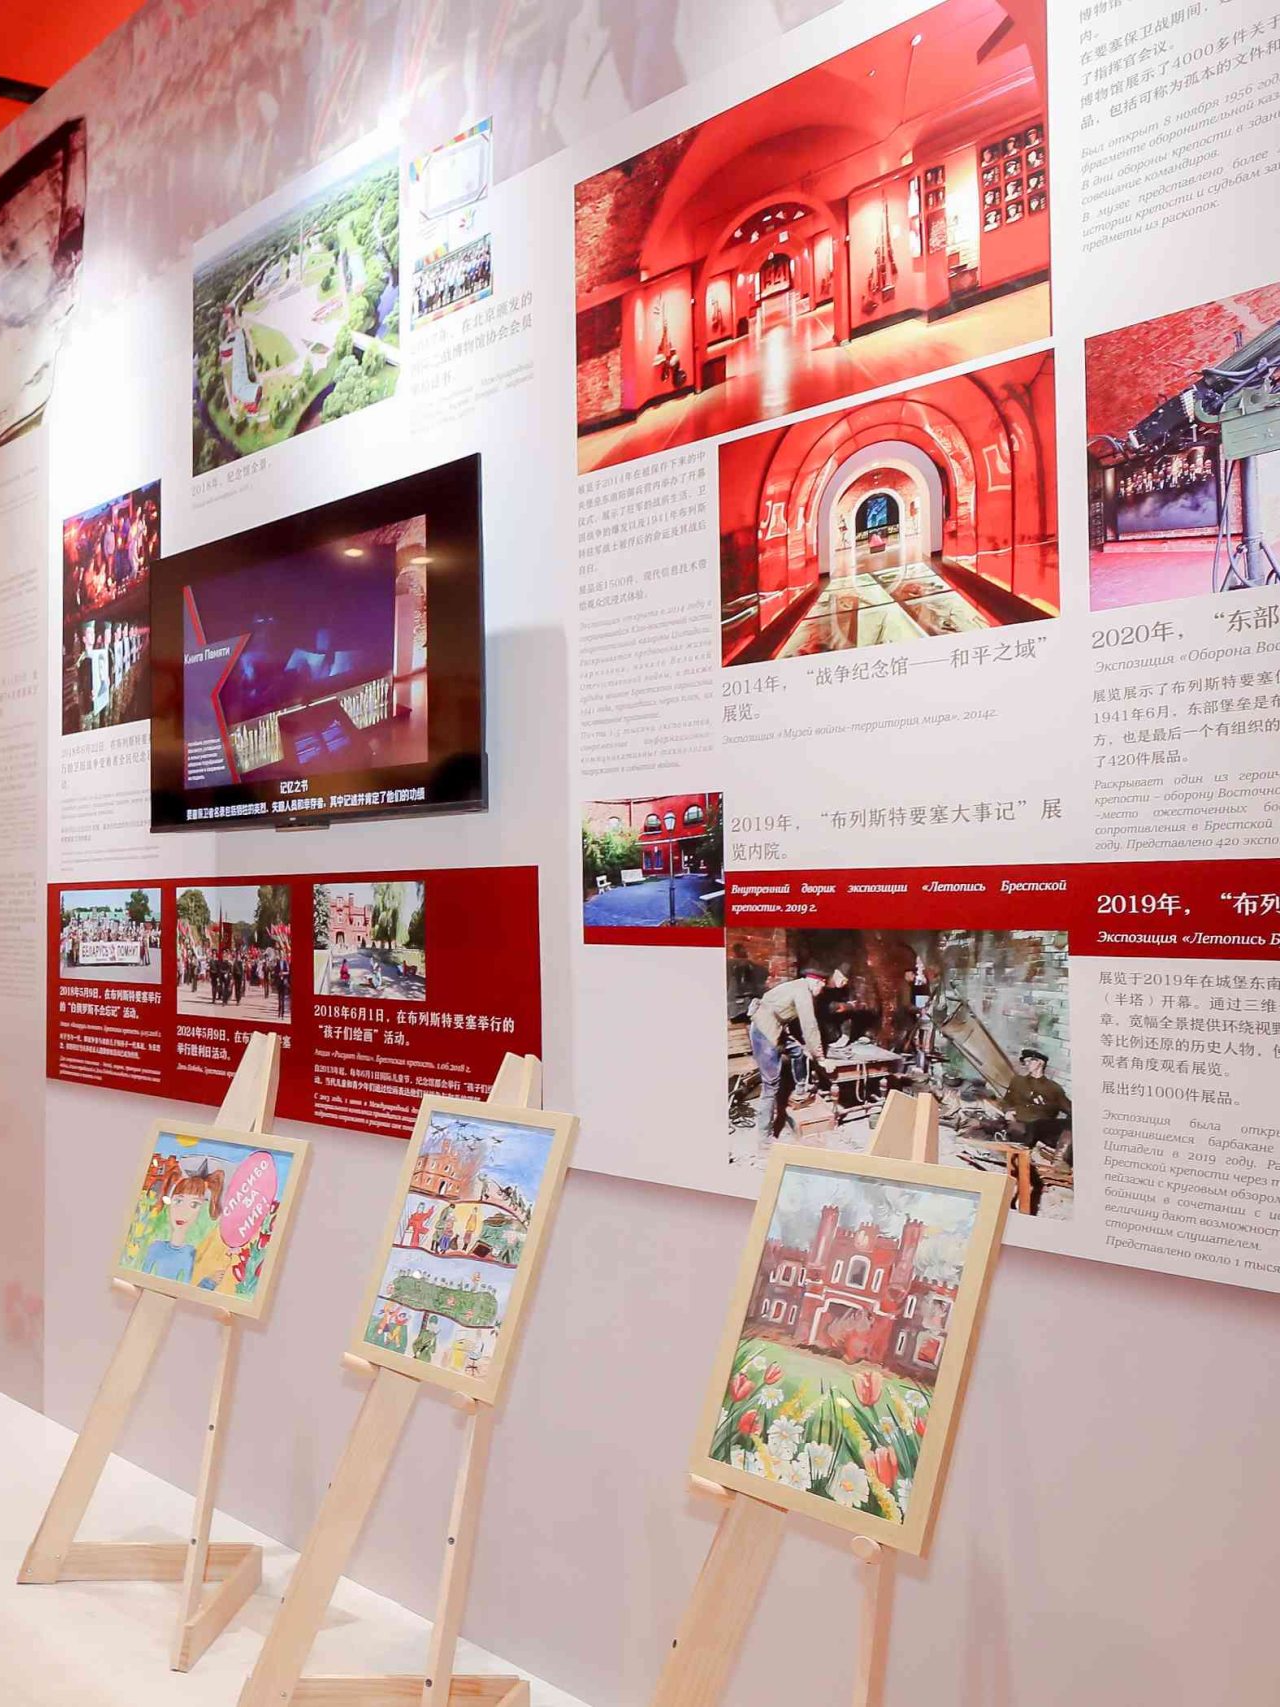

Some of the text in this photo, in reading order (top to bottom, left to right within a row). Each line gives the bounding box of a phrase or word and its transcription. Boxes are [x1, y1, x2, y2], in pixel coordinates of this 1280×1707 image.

[1163, 115, 1173, 127] 8
[1176, 99, 1219, 122] ноября
[1225, 84, 1253, 104] 1956
[1257, 73, 1280, 90] год
[1232, 149, 1269, 169] более
[1081, 180, 1090, 191] В
[1094, 655, 1174, 673] Экспозиция
[1180, 645, 1251, 664] «Оборона
[722, 702, 761, 724] 展览。
[1095, 749, 1189, 769] 了420件展品。
[280, 780, 308, 794] 记忆之书
[1094, 778, 1164, 792] Раскрывает
[1174, 774, 1204, 786] один
[1214, 773, 1229, 782] из
[1094, 795, 1150, 808] крепости
[1163, 791, 1214, 803] оборону
[1153, 805, 1247, 818] ожесточенных
[1095, 819, 1273, 837] сопротивления в Брестской
[731, 842, 789, 861] 览内院。
[1126, 838, 1213, 852] Представлено
[1216, 838, 1239, 849] 420
[1242, 836, 1280, 849] экспо
[731, 880, 1067, 895] Внутренний дворик экспозиции «Летопись Брестской
[732, 903, 783, 915] крепости».
[785, 903, 808, 915] 2019
[1097, 931, 1266, 946] Экспозиция «Летопись
[1099, 971, 1280, 990] 展览于2019年在城堡东南
[314, 1004, 515, 1033] 2018年6月1日，在布列斯特要塞举行的
[1101, 1055, 1230, 1077] 观者角度观看展览。
[1102, 1080, 1240, 1106] 展出约1000件展品。
[1102, 1109, 1171, 1127] Экспозиция
[1190, 1119, 1221, 1131] была
[1103, 1127, 1274, 1154] сохранившемся барбакане
[1103, 1140, 1164, 1157] Цитадели
[1187, 1151, 1217, 1165] 2019
[1225, 1156, 1257, 1171] году.
[1104, 1156, 1268, 1186] Брестской крепости через
[223, 1160, 269, 1217] СПАСИБО
[1105, 1172, 1155, 1187] пейзажи
[1167, 1181, 1228, 1197] круговым
[242, 1189, 260, 1209] ЗА
[1105, 1187, 1156, 1203] бойницы
[1177, 1198, 1246, 1216] сочетании
[238, 1196, 271, 1238] МИР!
[1105, 1204, 1159, 1221] величину
[1162, 1210, 1197, 1225] дают
[1105, 1219, 1262, 1251] сторонним слушателем.
[1105, 1235, 1191, 1258] Представлено
[1194, 1252, 1231, 1265] около
